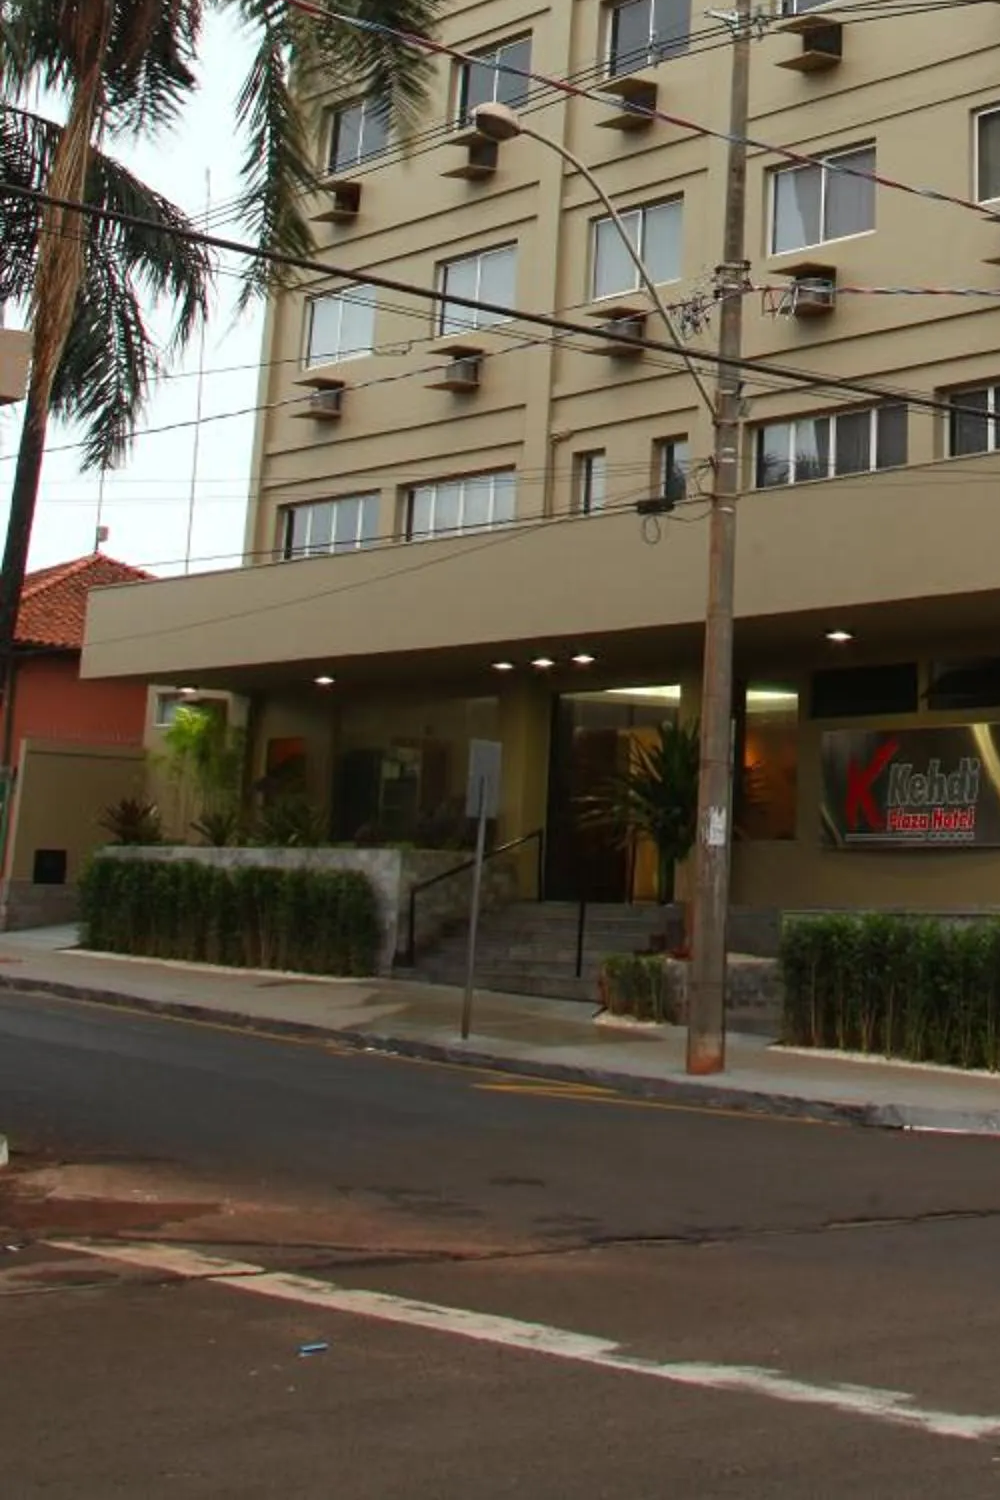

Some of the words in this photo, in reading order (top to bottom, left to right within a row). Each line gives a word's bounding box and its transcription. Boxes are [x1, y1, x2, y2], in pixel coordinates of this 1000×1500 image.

[845, 739, 899, 830] K
[887, 757, 981, 804] Kehdi
[887, 808, 930, 831] Plaza
[932, 806, 977, 831] Hotel
